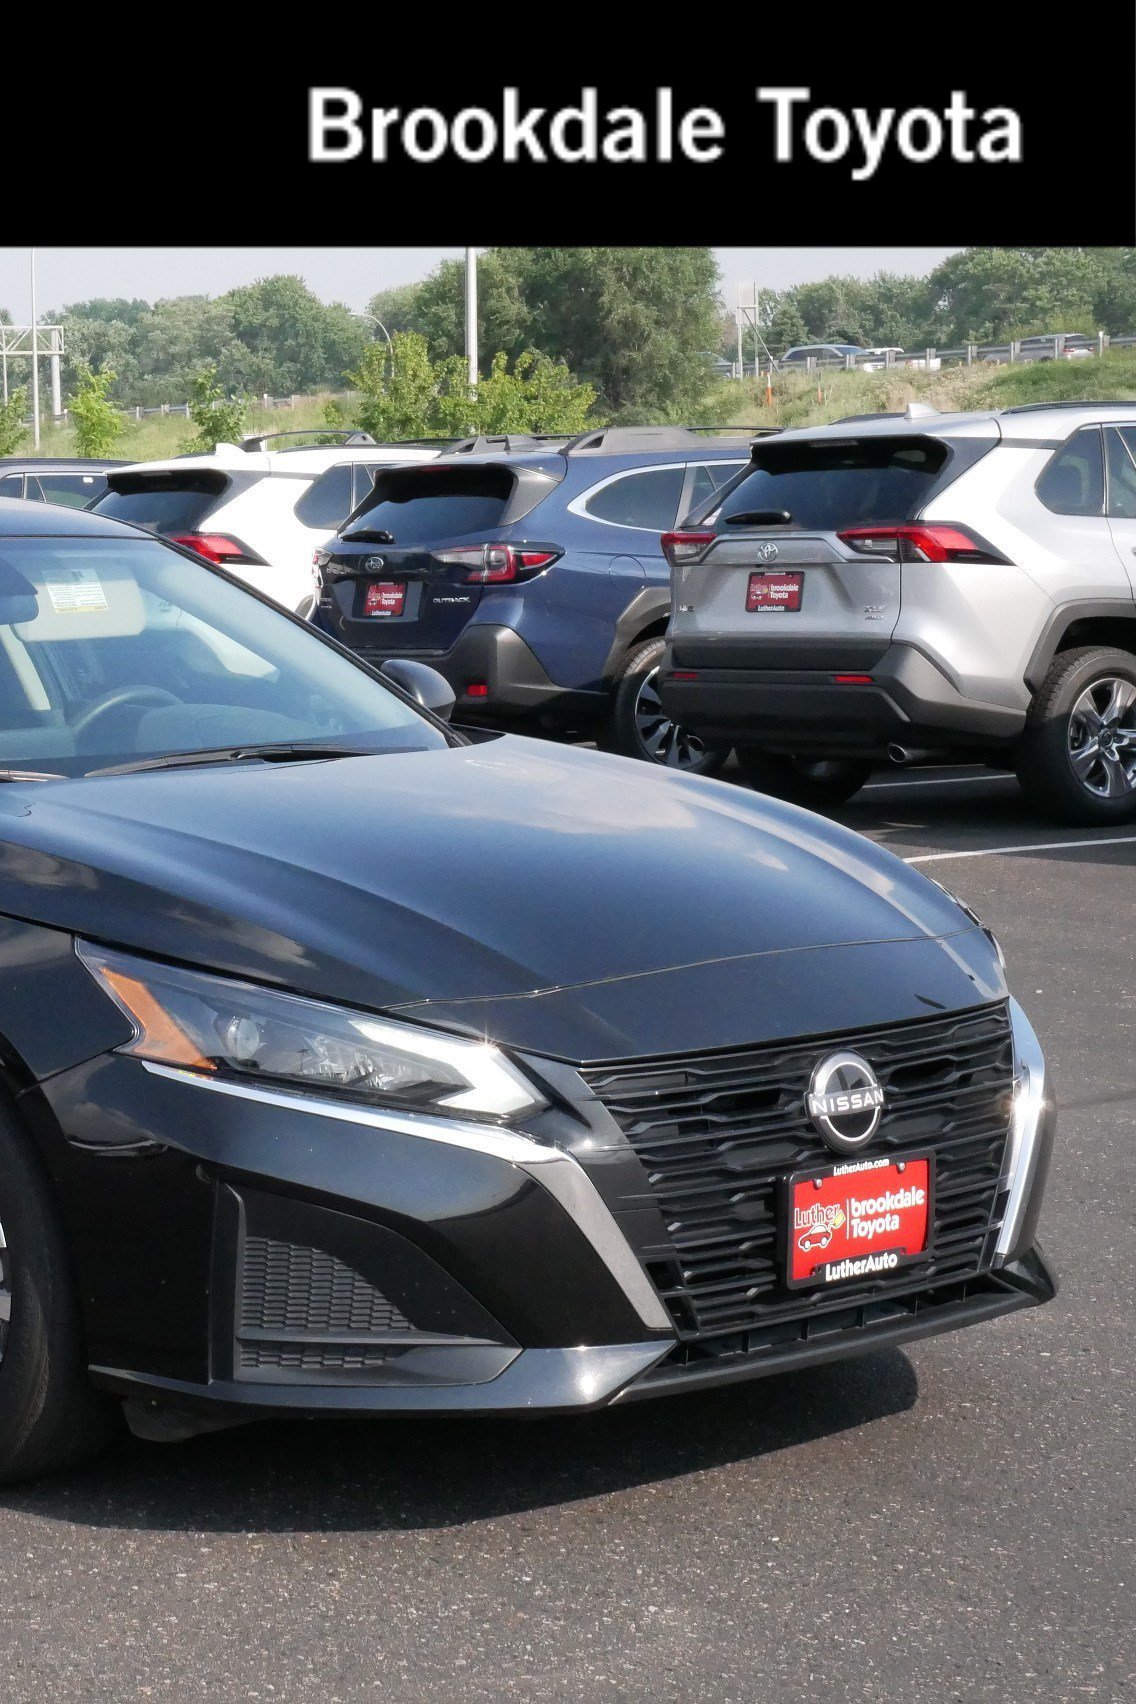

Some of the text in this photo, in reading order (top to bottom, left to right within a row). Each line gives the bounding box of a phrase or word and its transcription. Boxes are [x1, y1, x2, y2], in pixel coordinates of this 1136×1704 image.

[770, 592, 789, 600] Toyota
[812, 1088, 884, 1115] NISSAN
[833, 1158, 890, 1177] LutherAuto.com
[851, 1185, 925, 1217] brookdale
[794, 1203, 841, 1229] Luther
[851, 1213, 900, 1239] Toyota
[825, 1252, 898, 1281] LutherAuto
